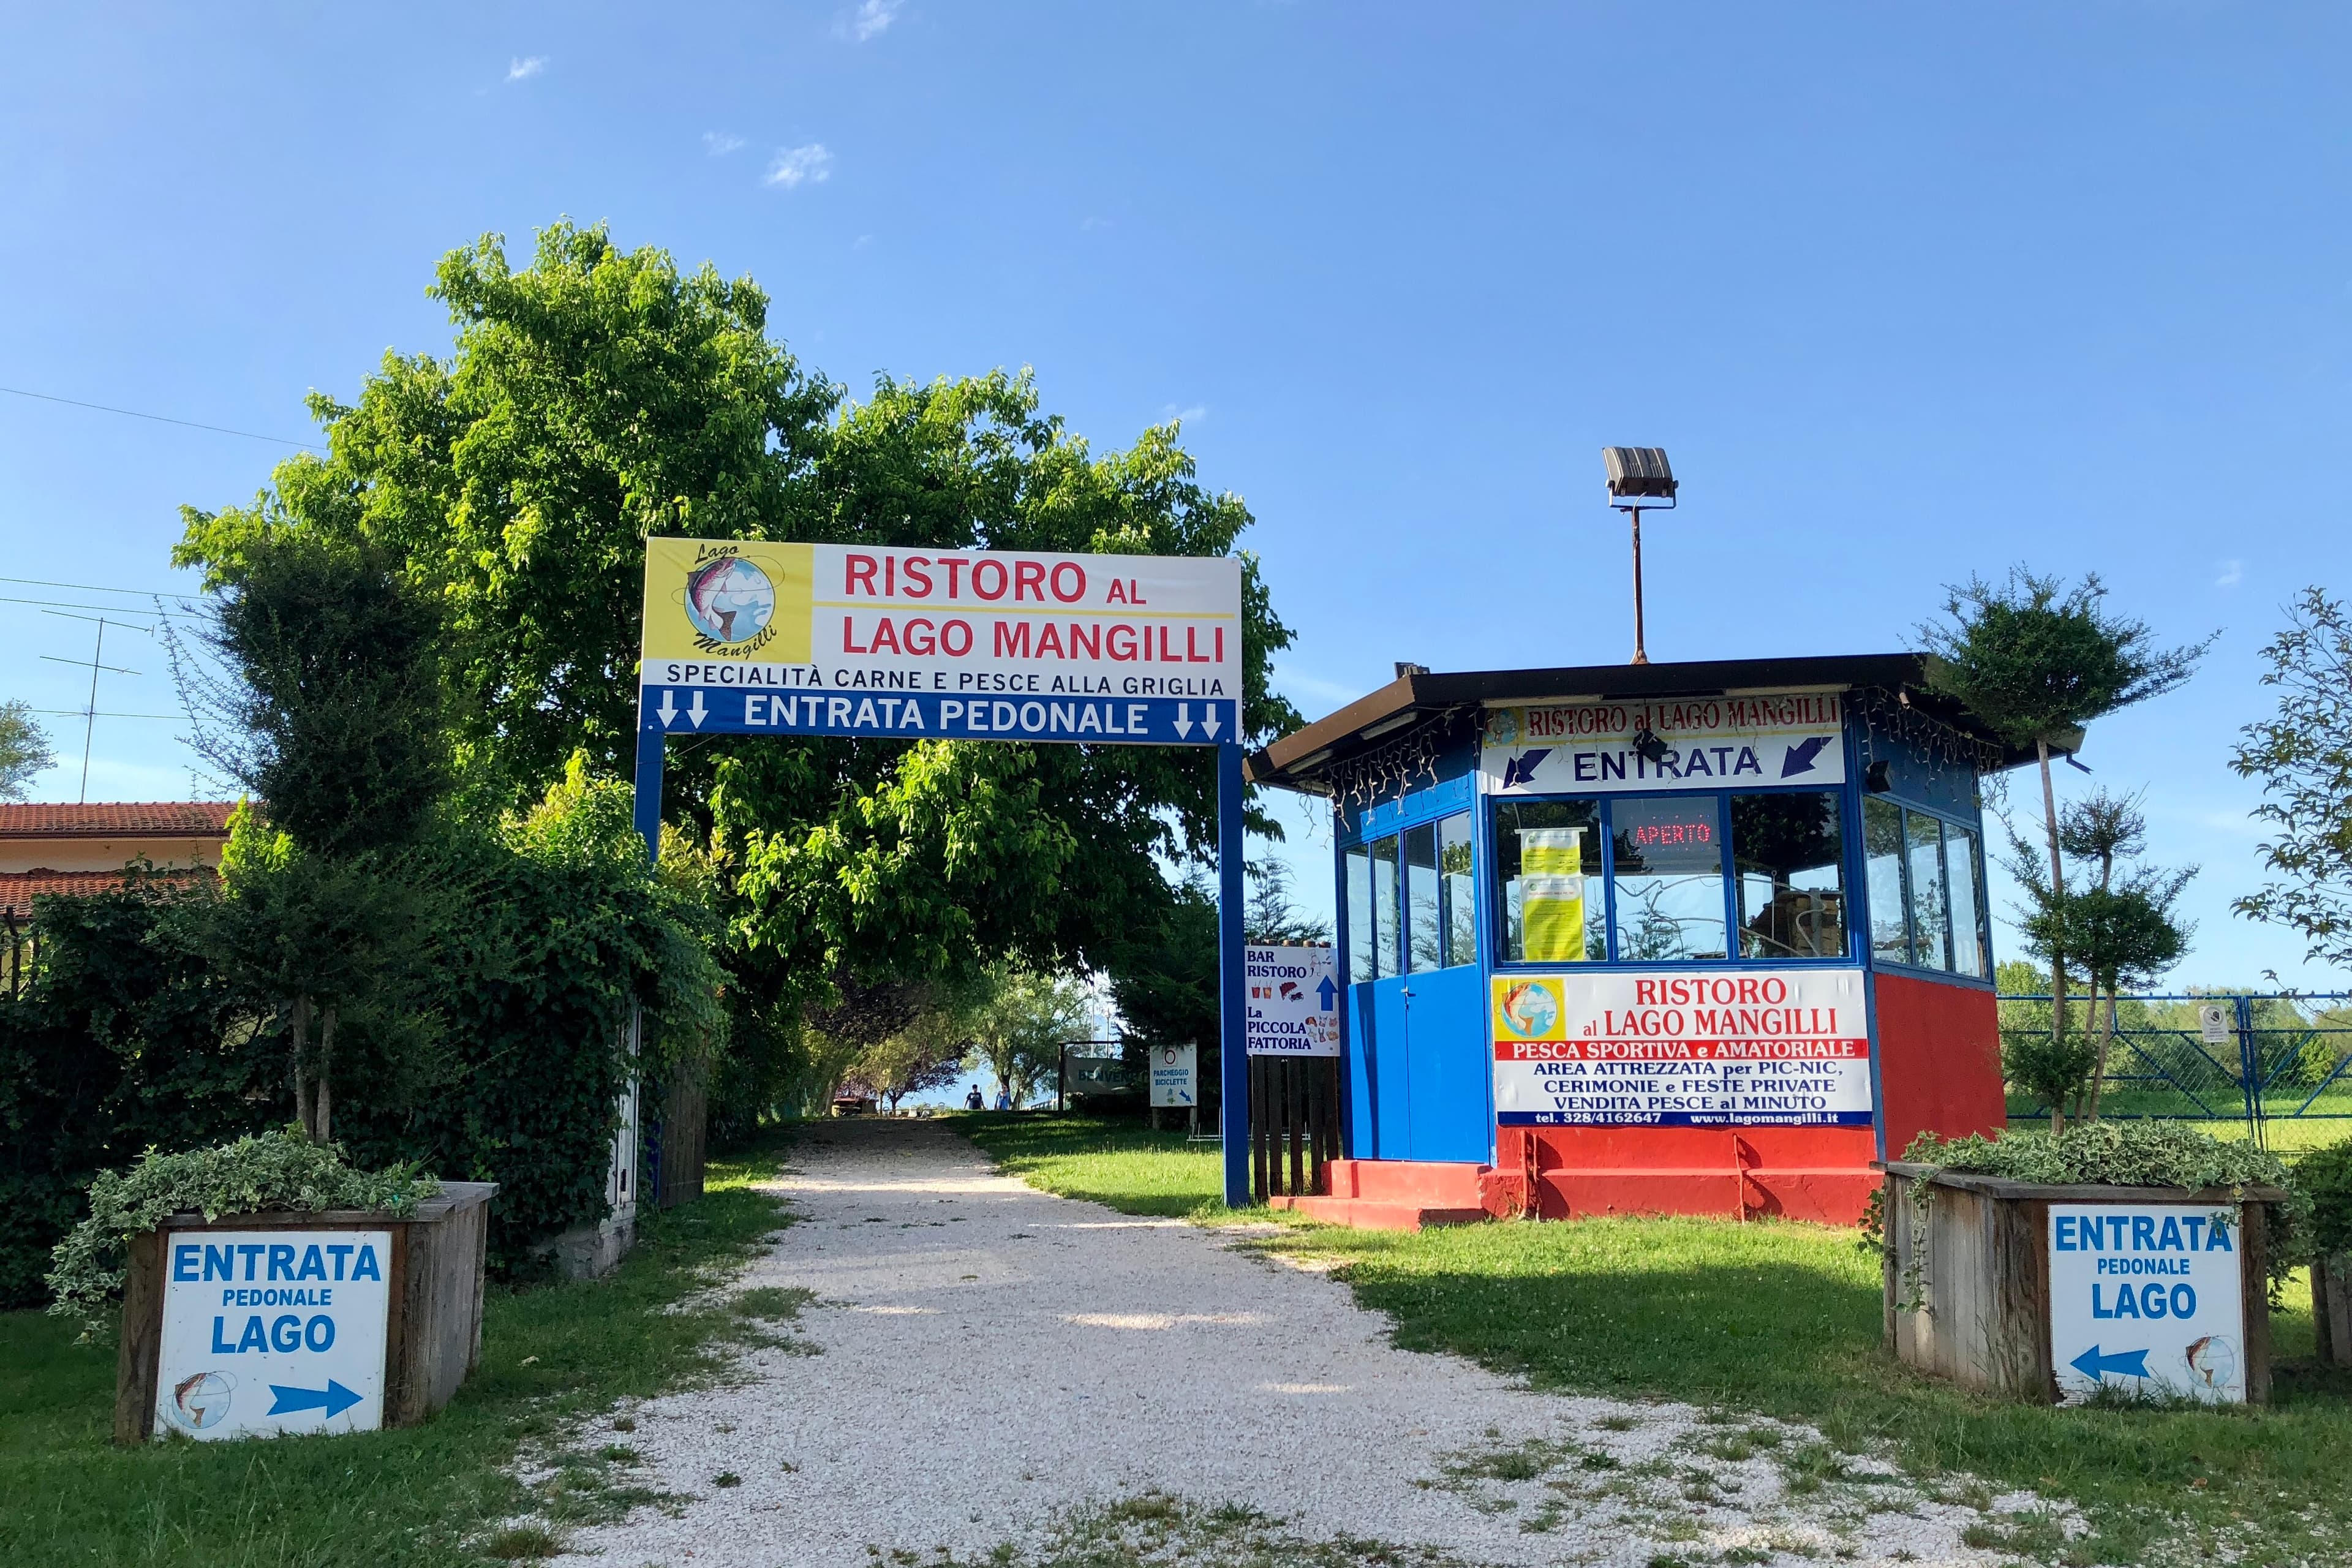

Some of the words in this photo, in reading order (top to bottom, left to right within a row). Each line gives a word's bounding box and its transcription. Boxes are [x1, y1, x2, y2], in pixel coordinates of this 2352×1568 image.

[695, 543, 739, 565] Lago
[846, 554, 1086, 603] RISTORO
[1106, 578, 1147, 605] AL
[693, 625, 777, 660] Mangilli
[843, 616, 973, 658] LAGO
[993, 621, 1223, 663] MANGILLI
[668, 663, 823, 687] SPECIALITÀ
[835, 668, 921, 689] CARNE
[935, 671, 945, 689] E
[959, 673, 1040, 692] PESCE
[1051, 674, 1110, 694] ALLA
[1122, 676, 1224, 696] GRIGLIA
[745, 695, 924, 730] ENTRATA
[940, 699, 1148, 735] PEDONALE
[1529, 706, 1627, 736] RISTORO
[1635, 705, 1652, 731] al
[1659, 703, 1720, 730] LAGO
[1727, 697, 1838, 726] MANGILLI
[1574, 746, 1762, 782] ENTRATA
[1635, 823, 1711, 845] APERTO
[1247, 951, 1275, 962] BAR
[1247, 966, 1306, 978] RISTORO
[1635, 978, 1787, 1006] RISTORO
[1248, 1006, 1262, 1018] La
[1583, 1020, 1597, 1037] al
[1605, 1009, 1684, 1037] LAGO
[1695, 1008, 1838, 1036] MANGILLI
[1248, 1022, 1306, 1035] PICCOLA
[1248, 1037, 1311, 1050] FATTORIA
[1513, 1043, 1578, 1058] PESCA
[1586, 1042, 1691, 1058] SPORTIVA
[1697, 1046, 1708, 1057] e
[1714, 1041, 1855, 1057] AMATORIALE
[1078, 1069, 1144, 1083] BENVEN
[1534, 1063, 1587, 1076] AREA
[1593, 1062, 1715, 1075] ATTREZZATA
[1723, 1064, 1752, 1079] per
[1759, 1061, 1843, 1076] PIC-NIC,
[1544, 1080, 1659, 1093] CERIMONIE
[1665, 1083, 1676, 1093] e
[1683, 1080, 1744, 1093] FESTE
[1751, 1079, 1836, 1092] PRIVATE
[1554, 1097, 1642, 1110] VENDITA
[1648, 1097, 1714, 1109] PESCE
[1721, 1098, 1736, 1109] al
[1743, 1096, 1826, 1110] MINUTO
[1536, 1114, 1559, 1123] tel.
[1564, 1113, 1660, 1124] 328/4162647
[1691, 1112, 1839, 1125] www.lagomangilli.it
[2056, 1216, 2233, 1251] ENTRATA
[173, 1245, 381, 1282] ENTRATA
[2098, 1258, 2190, 1275] PEDONALE
[223, 1289, 332, 1306] PEDONALE
[2092, 1283, 2196, 1319] LAGO
[211, 1314, 335, 1354] LAGO
